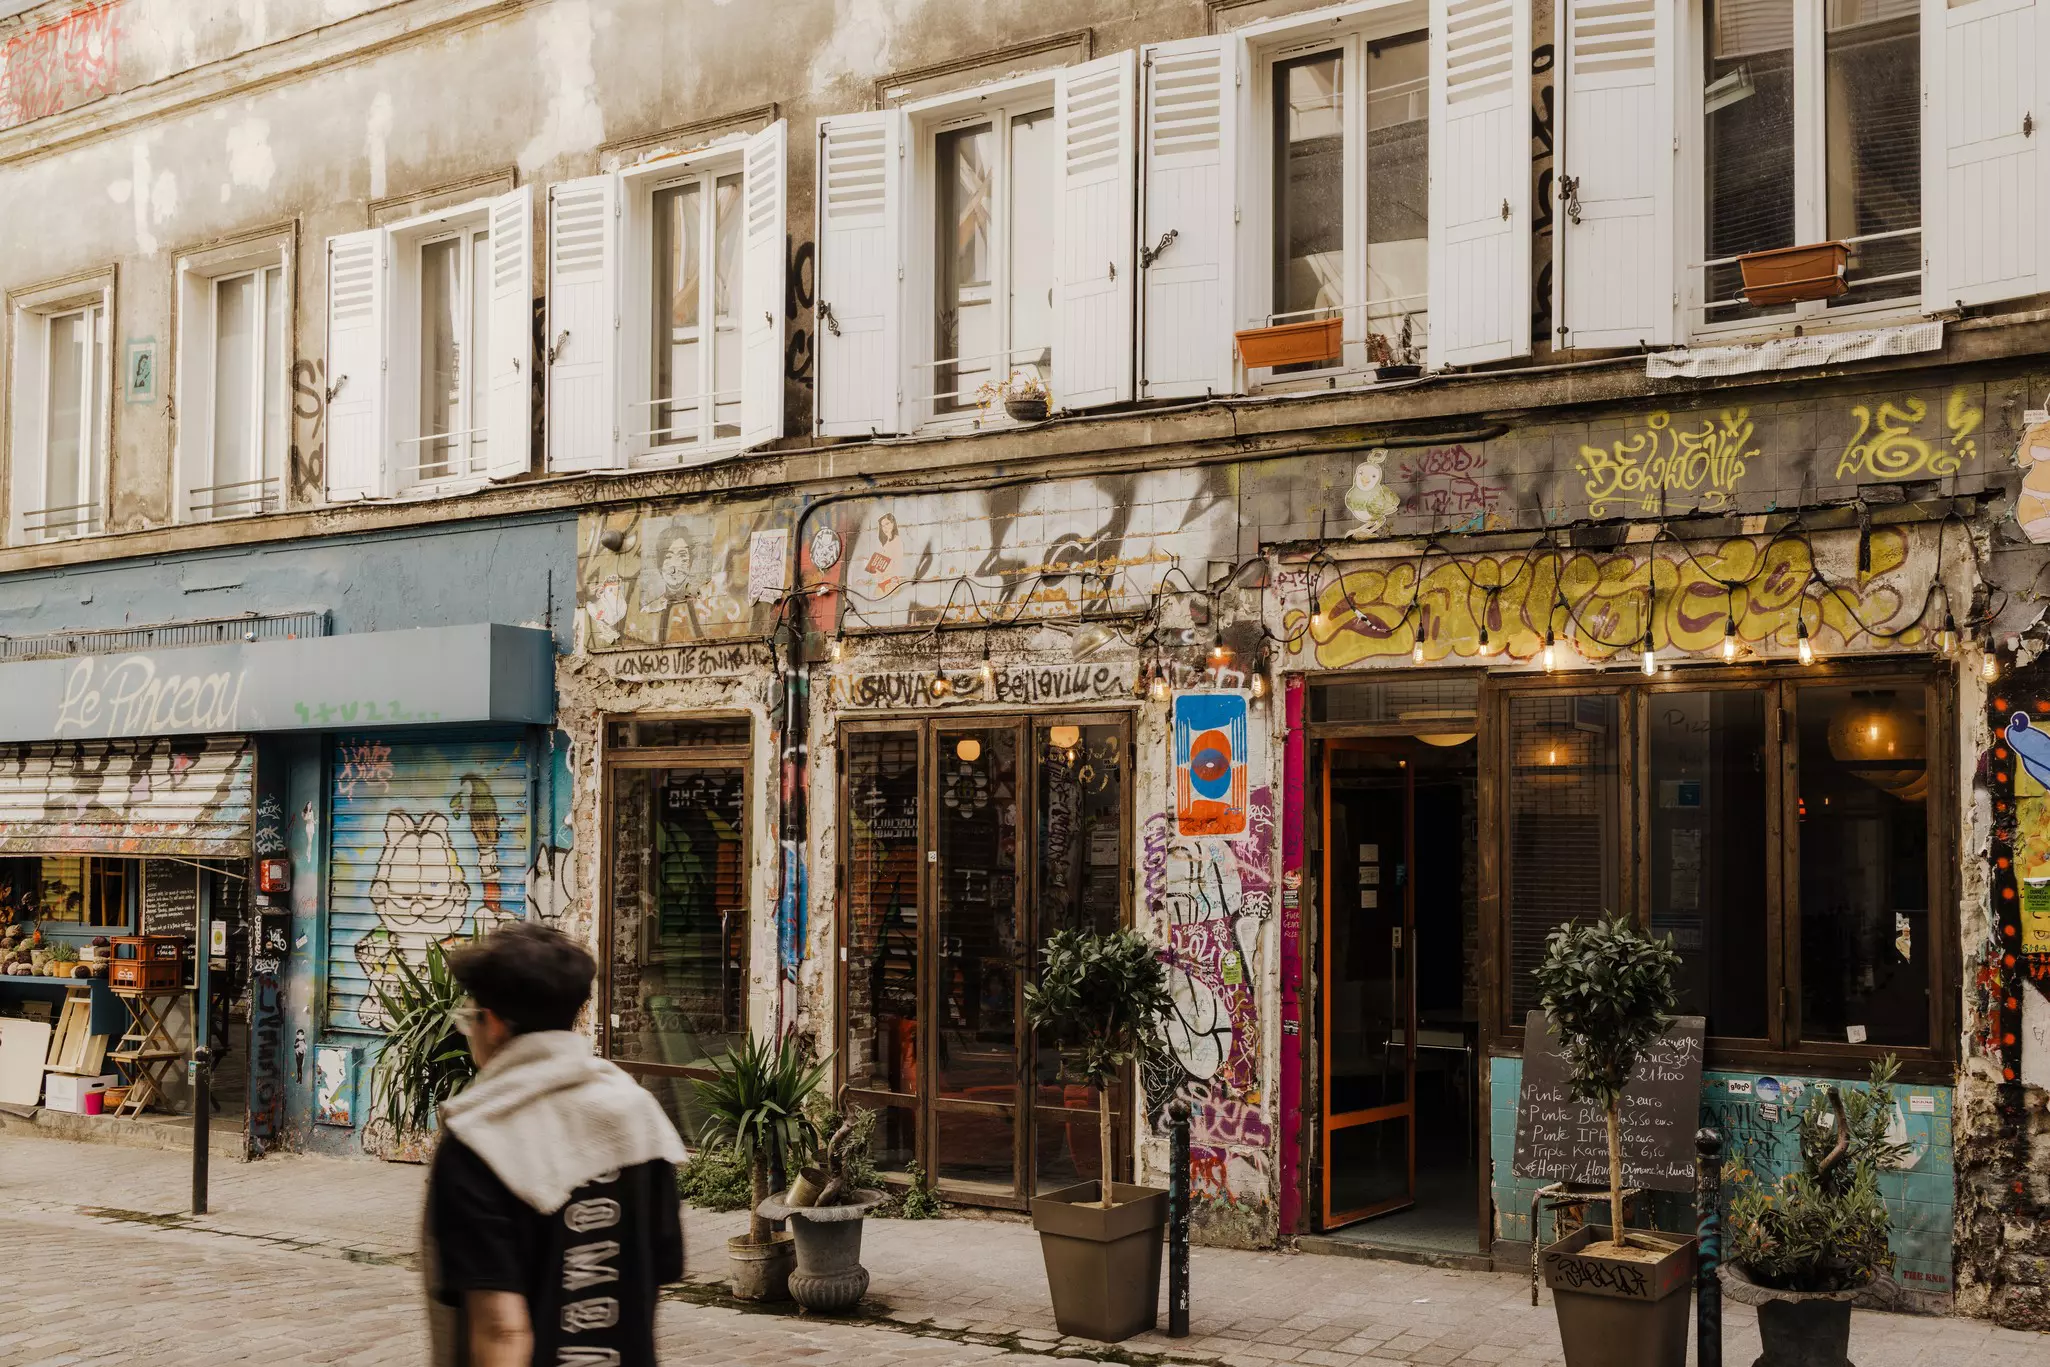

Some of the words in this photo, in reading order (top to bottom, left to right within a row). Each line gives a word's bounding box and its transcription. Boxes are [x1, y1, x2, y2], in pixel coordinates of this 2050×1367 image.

[54, 656, 101, 734] Le
[1527, 1084, 1565, 1102] Pinte
[1529, 1105, 1574, 1123] Pinte
[1531, 1125, 1570, 1143] Pinte
[1577, 1127, 1609, 1143] IPA
